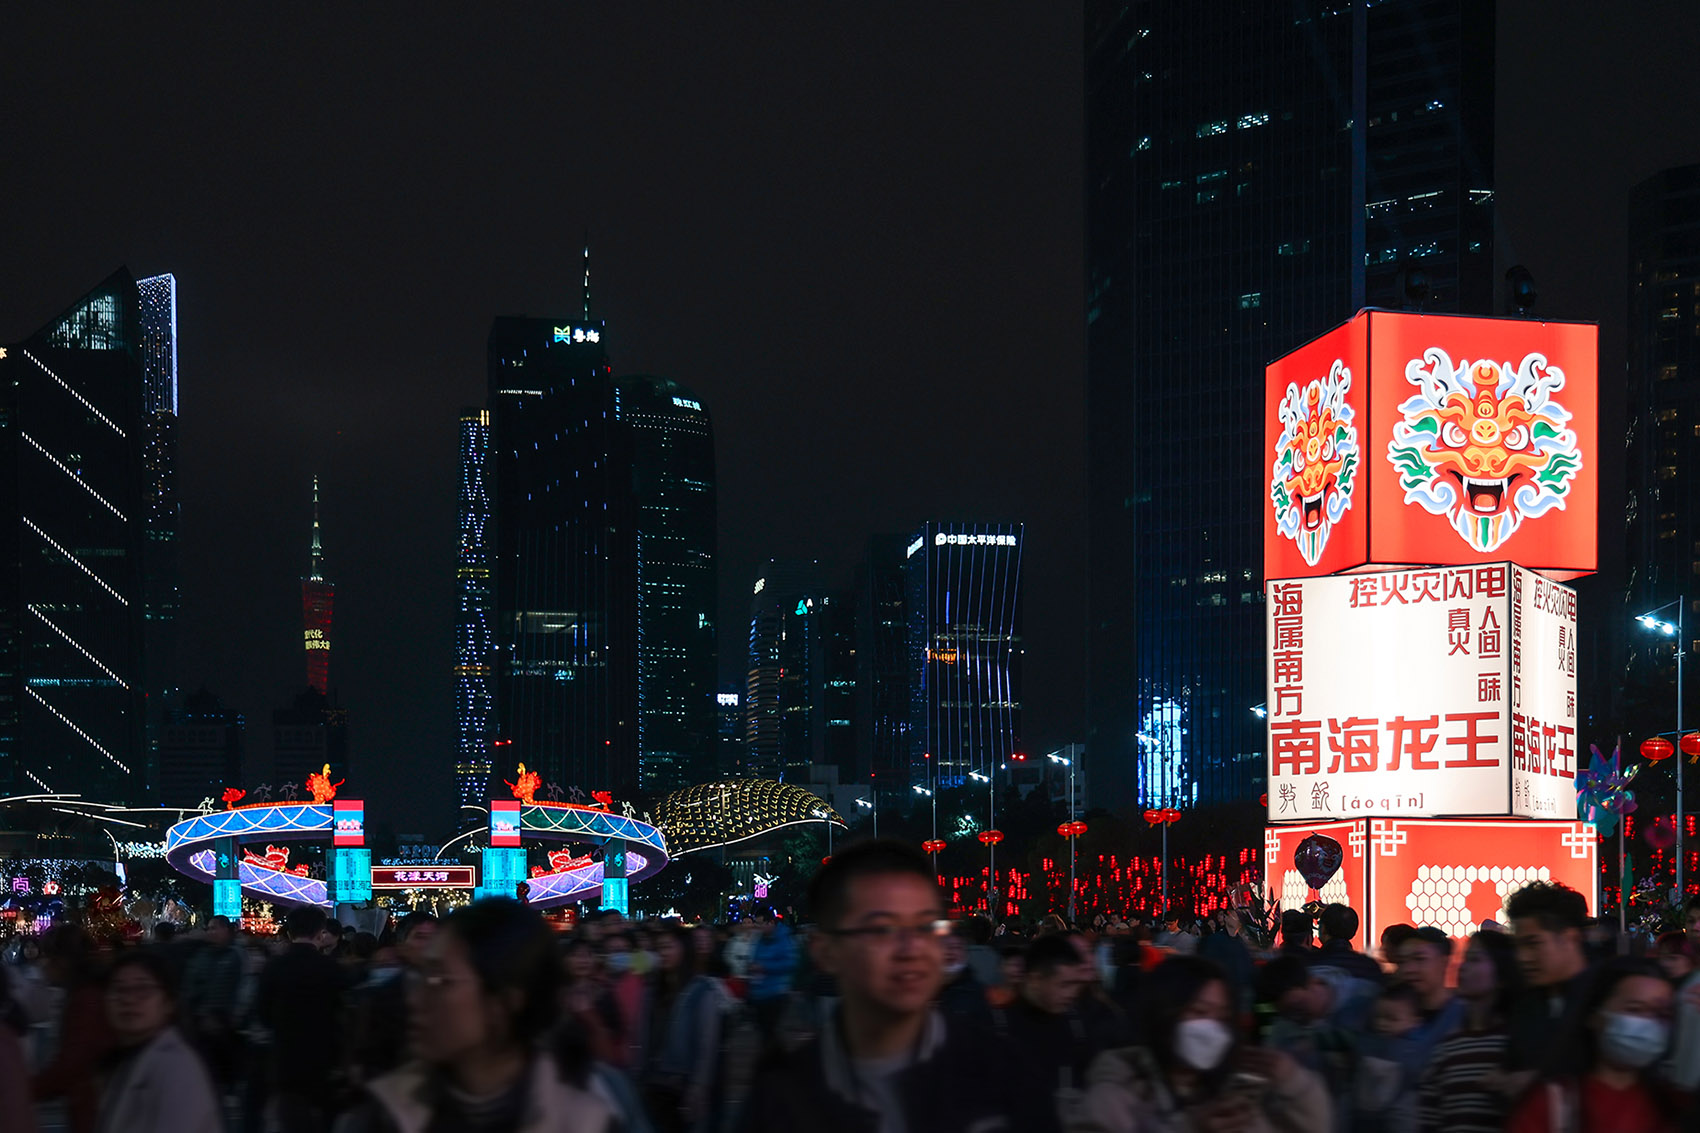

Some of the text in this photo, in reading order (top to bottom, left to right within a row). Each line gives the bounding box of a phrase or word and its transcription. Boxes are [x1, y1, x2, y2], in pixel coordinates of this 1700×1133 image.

[947, 534, 1016, 546] 中国太平洋保险
[1349, 566, 1506, 609] 控火灾闪电
[1273, 582, 1304, 717] 海属南方
[1448, 608, 1471, 656] 真火
[1271, 711, 1500, 776] 南海龙王
[1512, 711, 1576, 780] 南海龙王
[394, 871, 449, 882] 花漾天河
